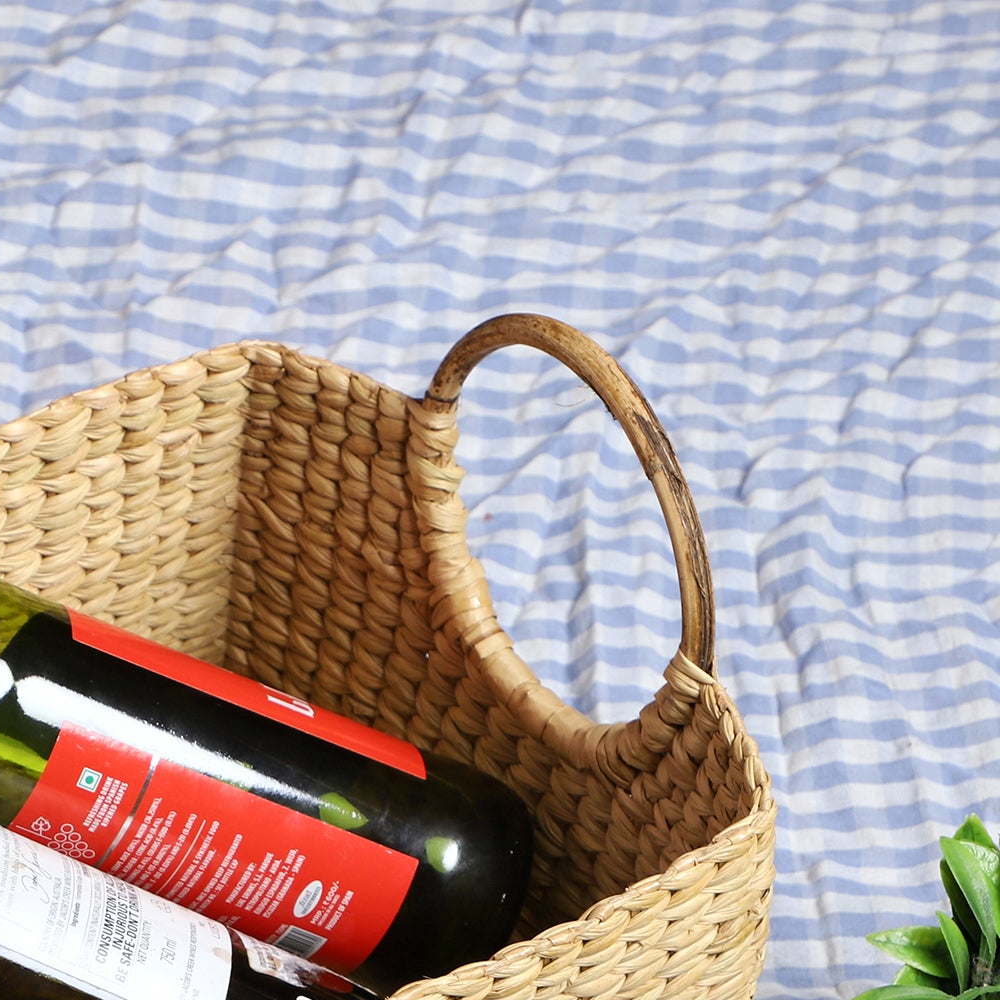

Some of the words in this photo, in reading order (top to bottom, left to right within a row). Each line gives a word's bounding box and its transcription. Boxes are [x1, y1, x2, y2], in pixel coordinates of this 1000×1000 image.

[104, 779, 121, 804] SPANISH
[113, 782, 128, 804] GRAPES
[341, 890, 354, 905] SPAIN
[94, 895, 115, 963] CONSUMPTION
[106, 885, 115, 896] OF
[111, 901, 127, 950] INJURIOUS
[119, 911, 138, 966] SAFE-DON'T
[163, 935, 176, 950] ml
[159, 946, 175, 965] 750
[114, 966, 128, 983] BE
